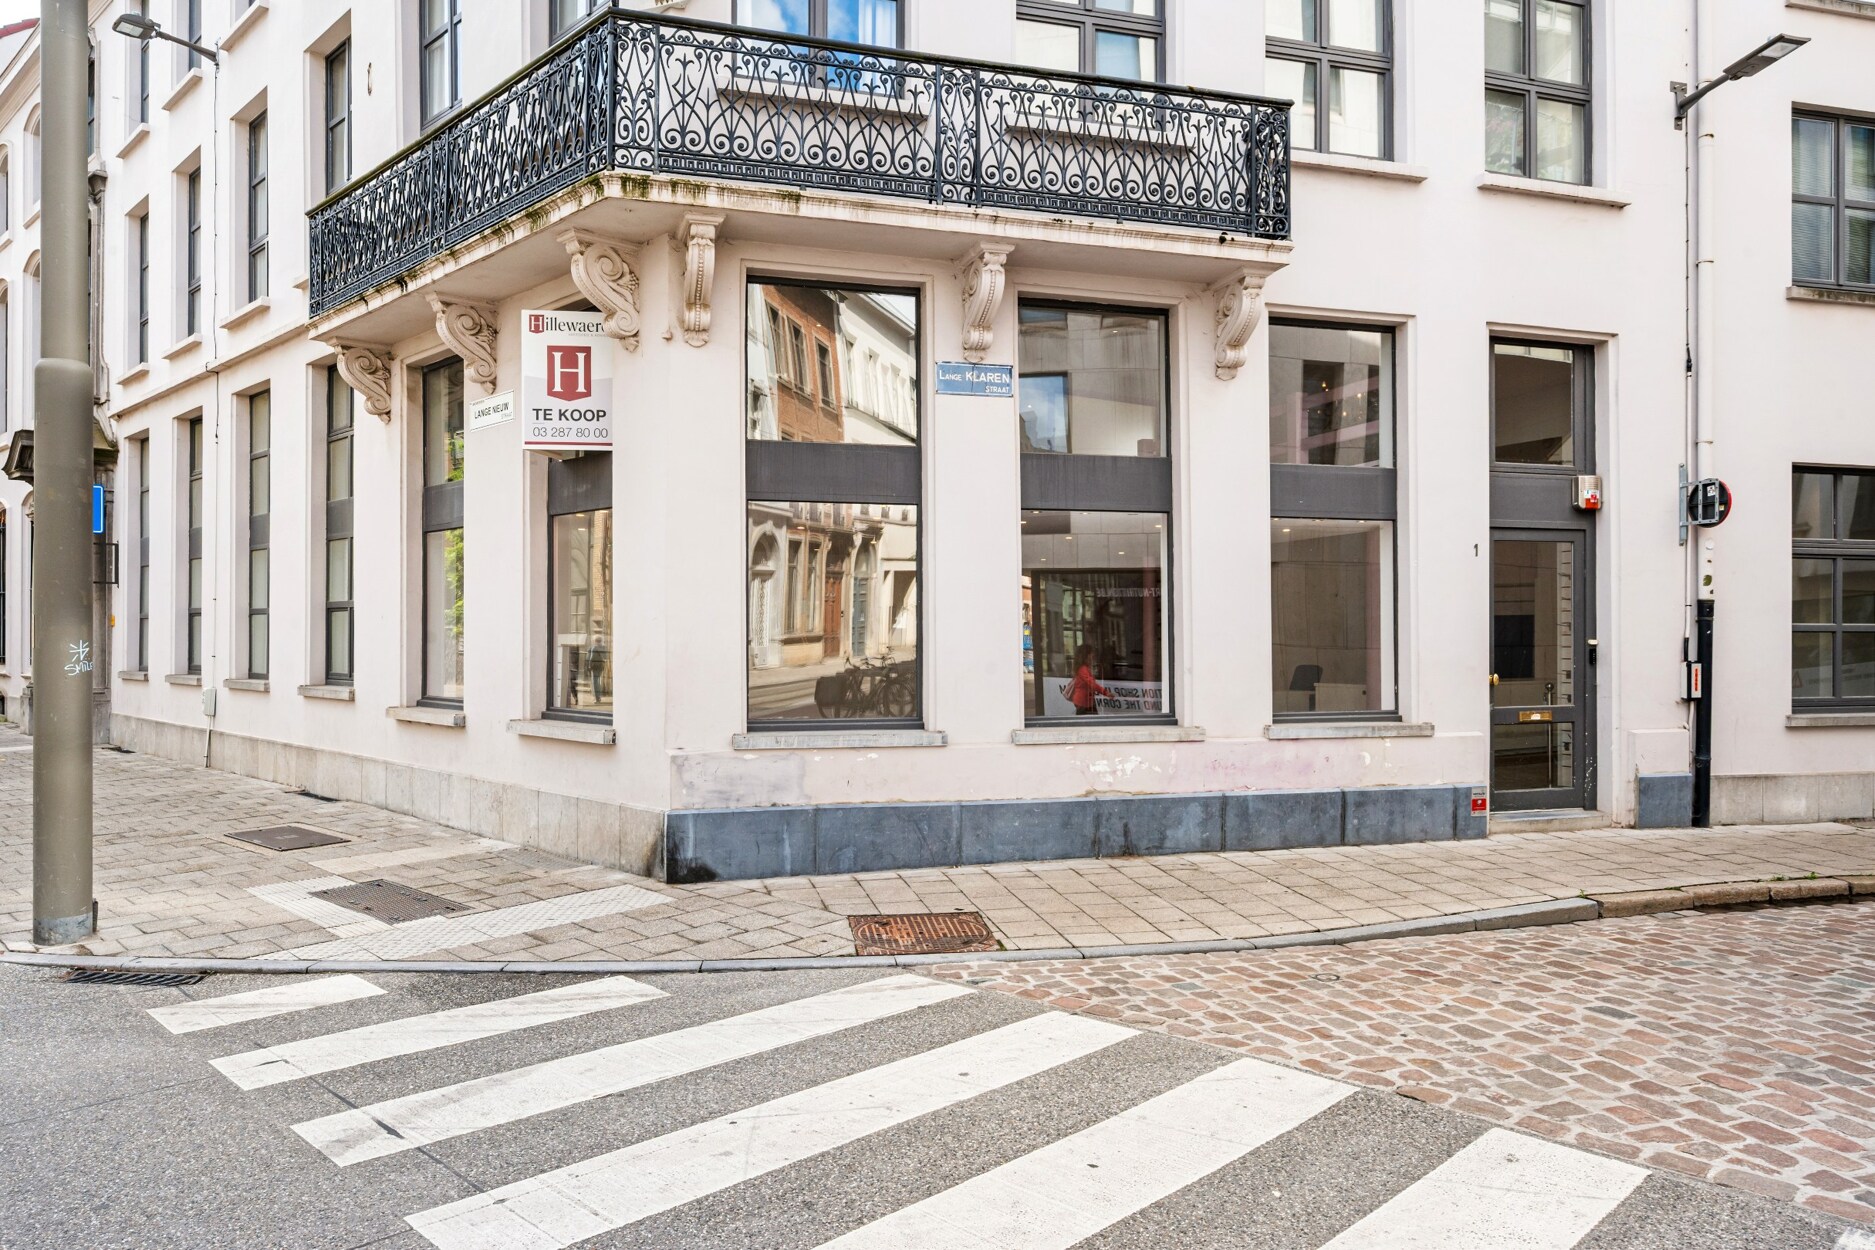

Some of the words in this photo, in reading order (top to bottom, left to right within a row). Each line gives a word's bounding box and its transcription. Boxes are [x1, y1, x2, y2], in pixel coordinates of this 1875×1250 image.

[529, 316, 604, 333] Hillewaer
[552, 351, 588, 393] H
[965, 371, 1010, 383] KLAREN
[985, 385, 1010, 393] STRAAT
[474, 406, 492, 420] LANGE
[492, 401, 510, 415] NIEUW
[532, 408, 553, 421] TE
[558, 408, 607, 422] KOOP
[532, 426, 548, 438] 03
[551, 427, 572, 438] 287
[575, 427, 590, 438] 80
[593, 427, 609, 439] 00
[1474, 544, 1478, 556] 1
